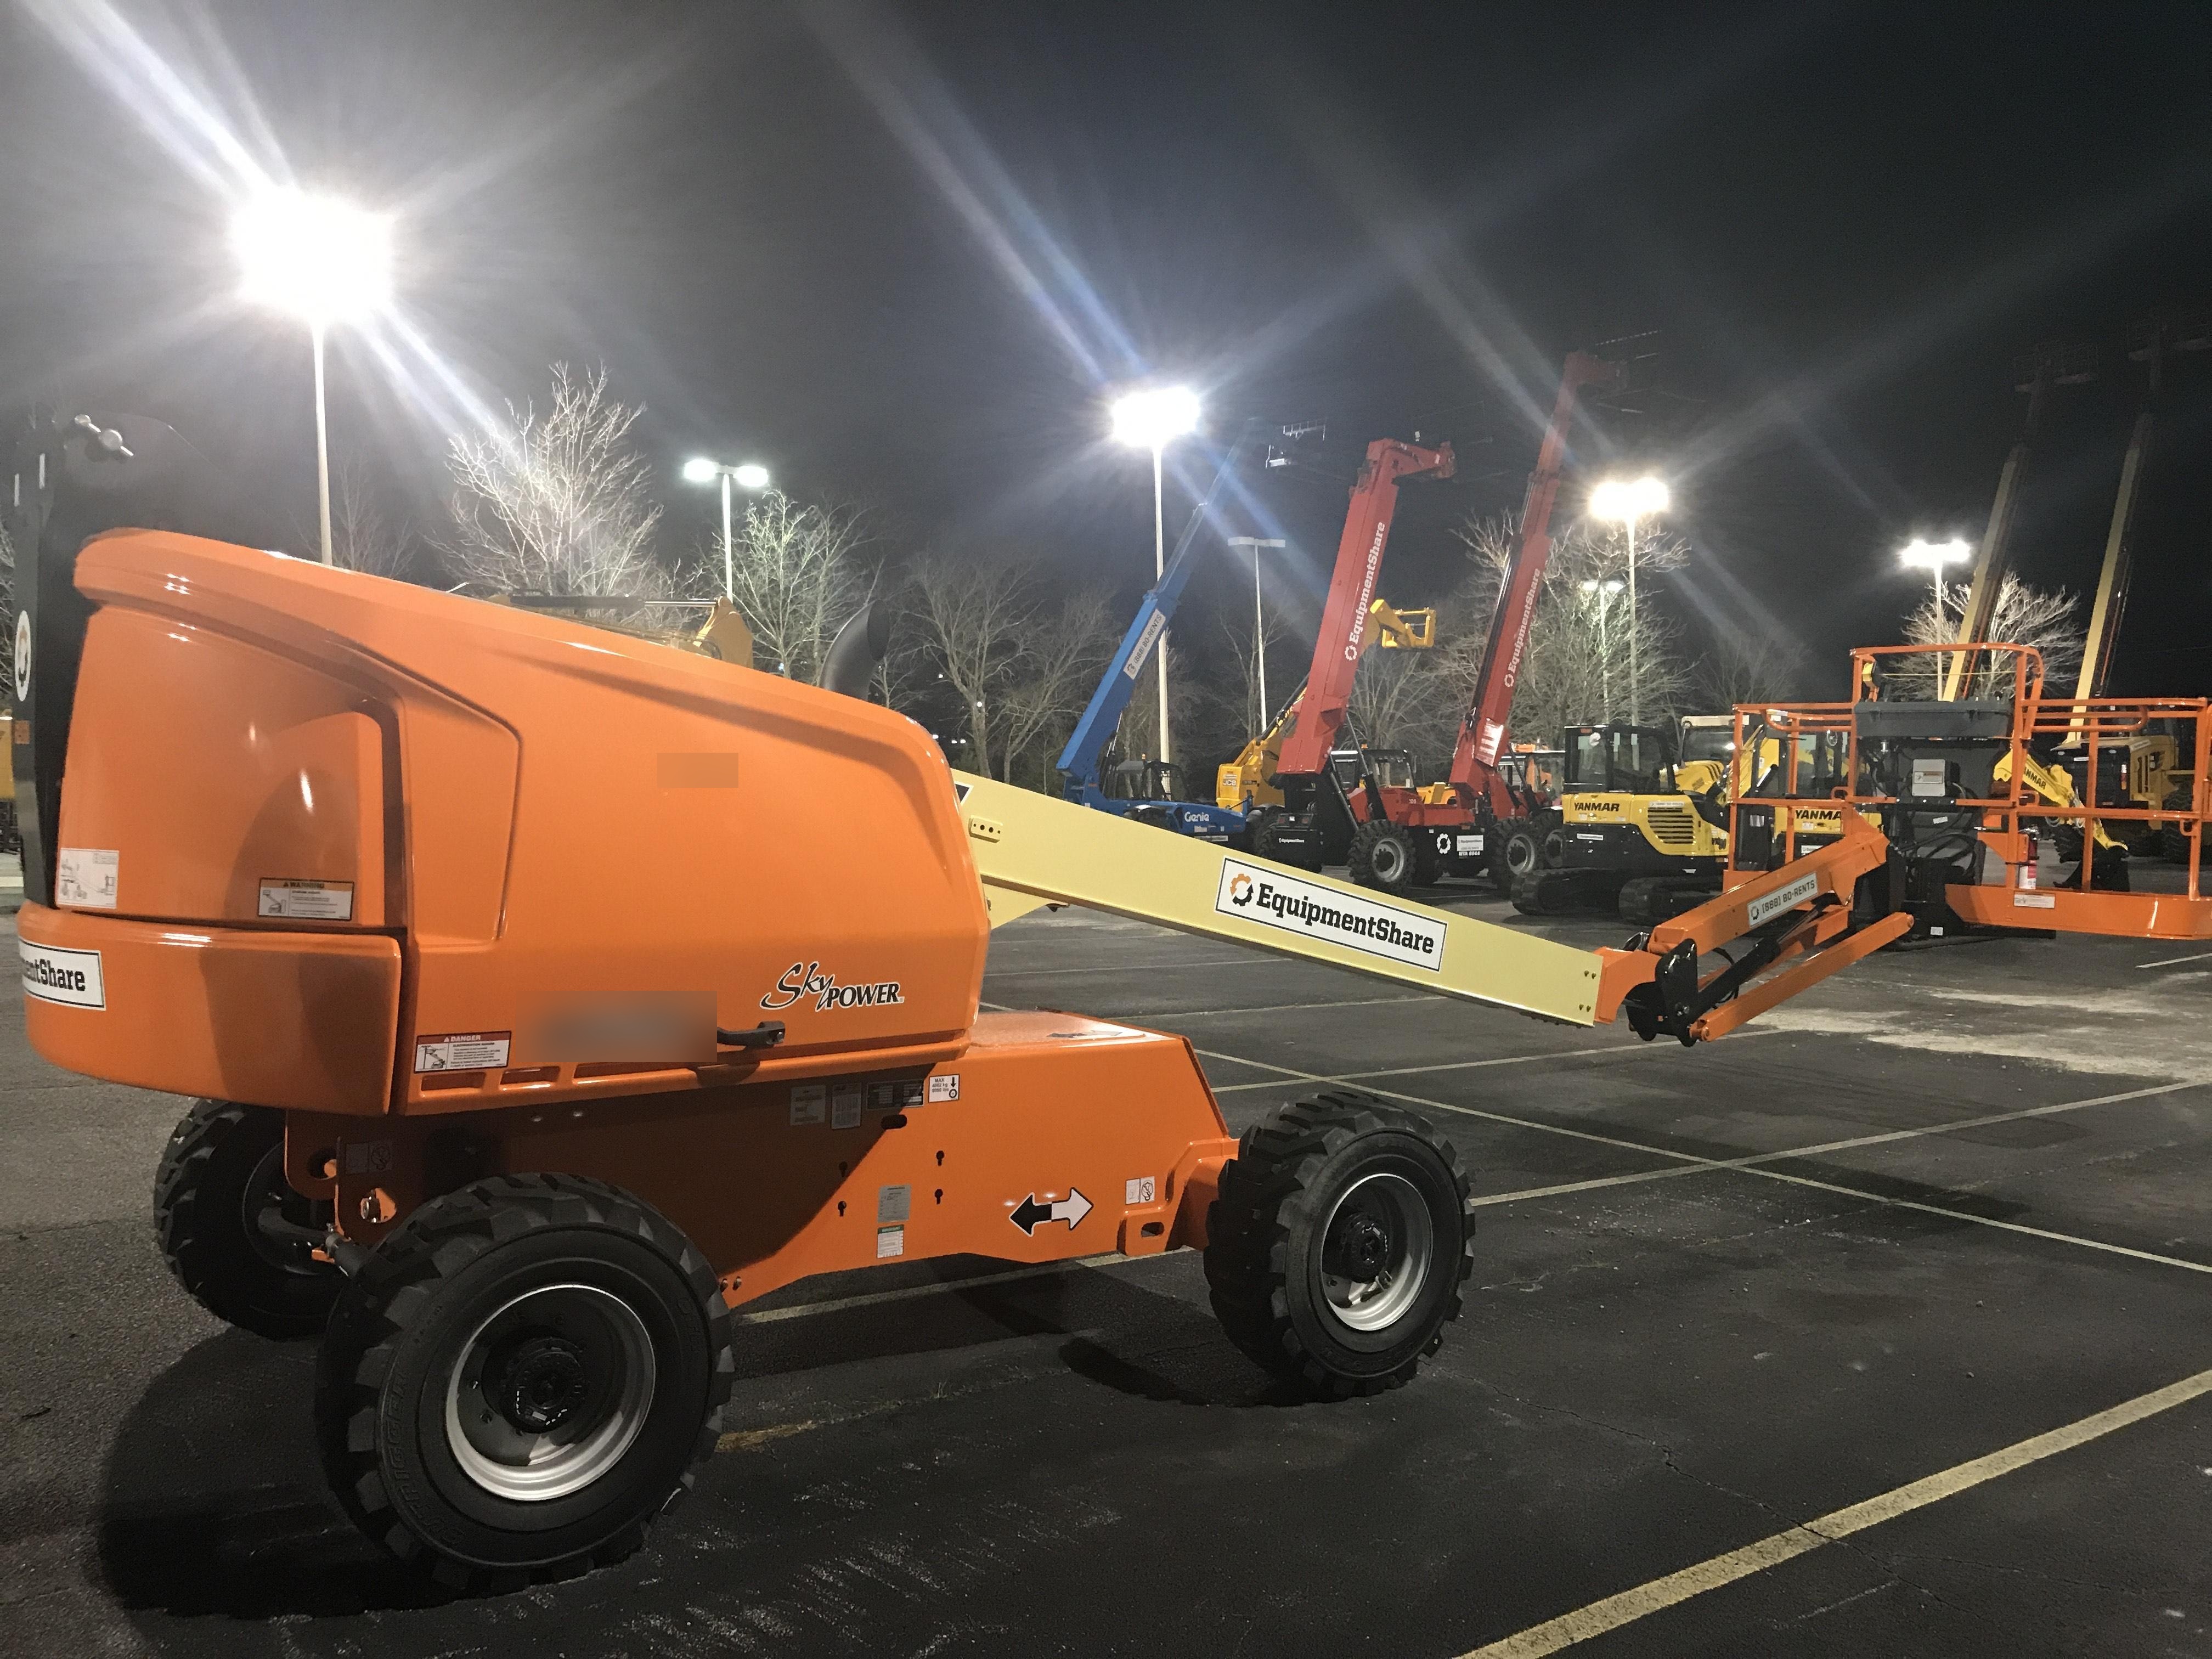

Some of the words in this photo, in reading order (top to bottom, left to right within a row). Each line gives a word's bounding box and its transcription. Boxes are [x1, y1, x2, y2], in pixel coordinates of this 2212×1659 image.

[1349, 522, 1385, 645] EquipmentShare
[1508, 568, 1541, 673] EquipmentShare
[2024, 767, 2046, 790] NMAR
[1184, 811, 1210, 822] Genie
[1574, 802, 1620, 812] YANMAR
[1762, 896, 1781, 913] (888)
[1783, 880, 1815, 903] 80-RENTS
[1256, 883, 1435, 954] EquipmentShare
[760, 961, 835, 1011] Sky
[825, 983, 900, 1008] POWER
